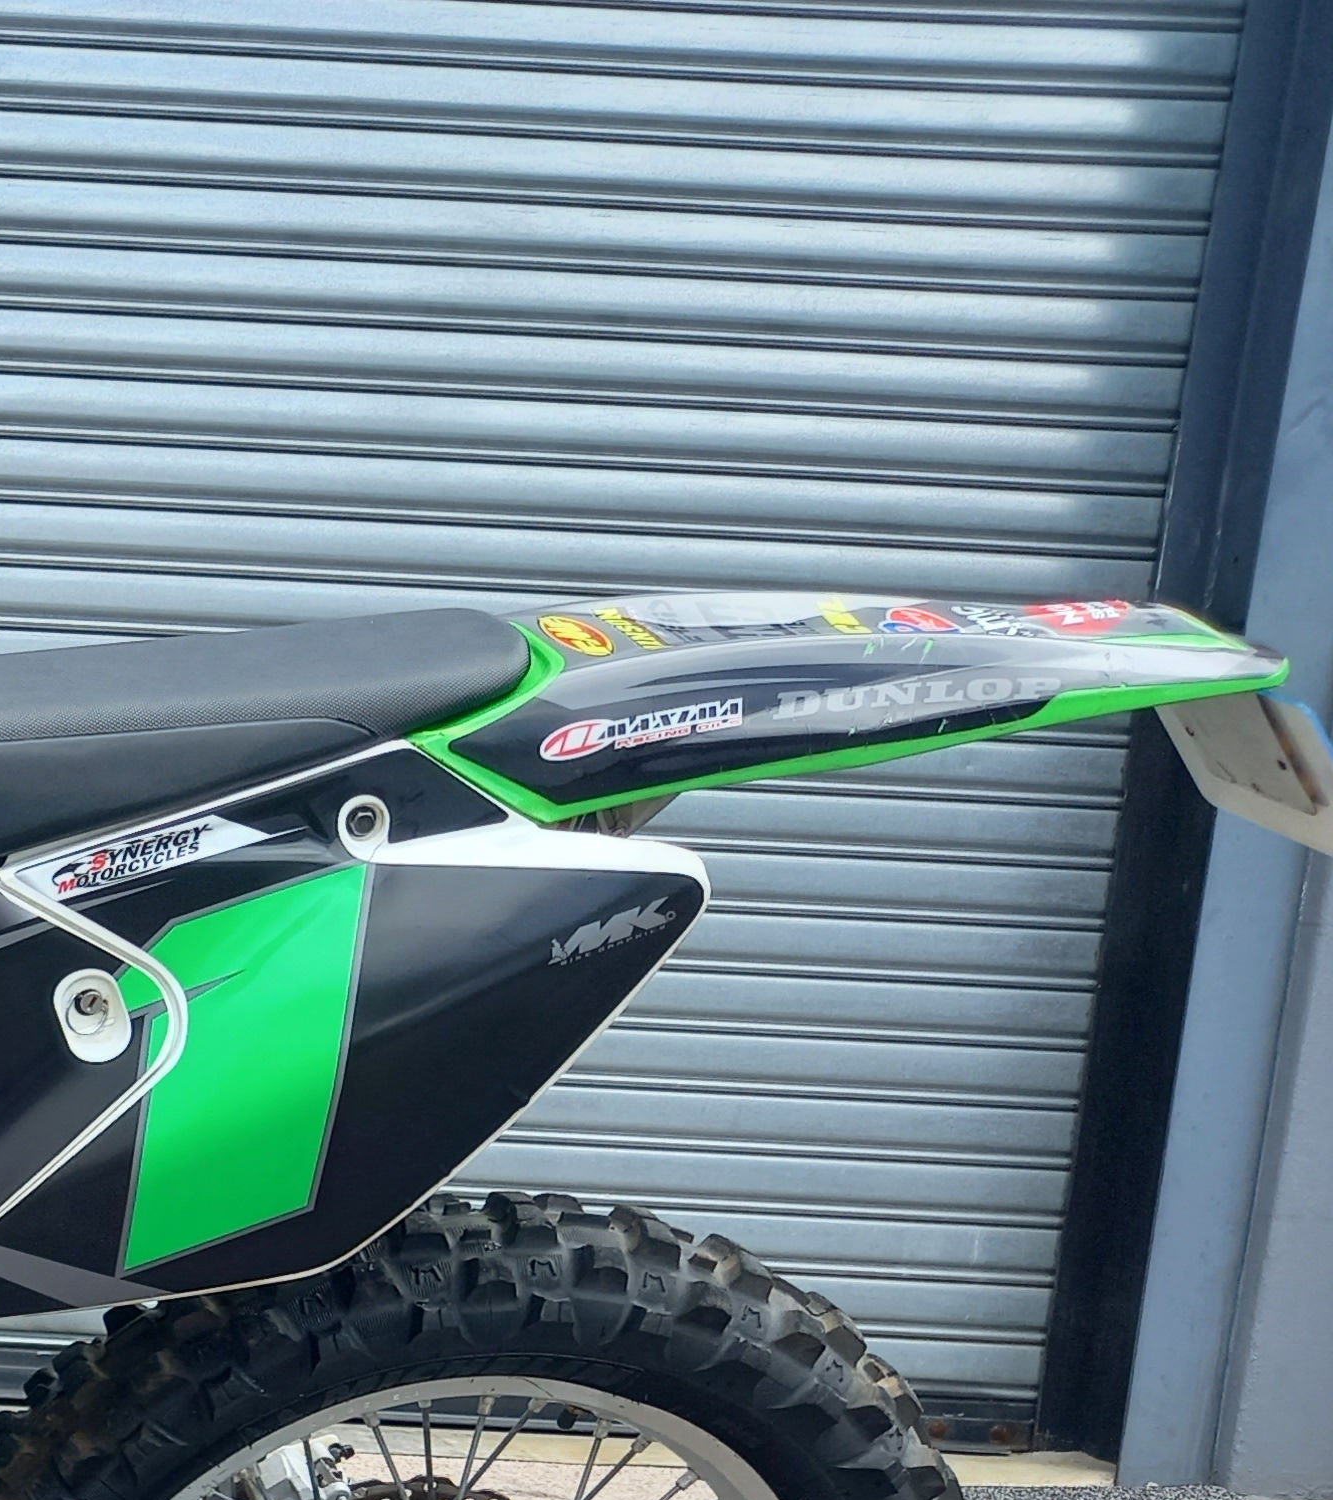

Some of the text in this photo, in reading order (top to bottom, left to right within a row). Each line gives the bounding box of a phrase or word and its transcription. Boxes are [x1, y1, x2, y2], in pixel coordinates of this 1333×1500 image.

[773, 677, 1061, 720] DUNLOP
[615, 726, 691, 748] RACING
[58, 841, 200, 895] MOTORCYCLES
[90, 824, 213, 871] SYNERGY
